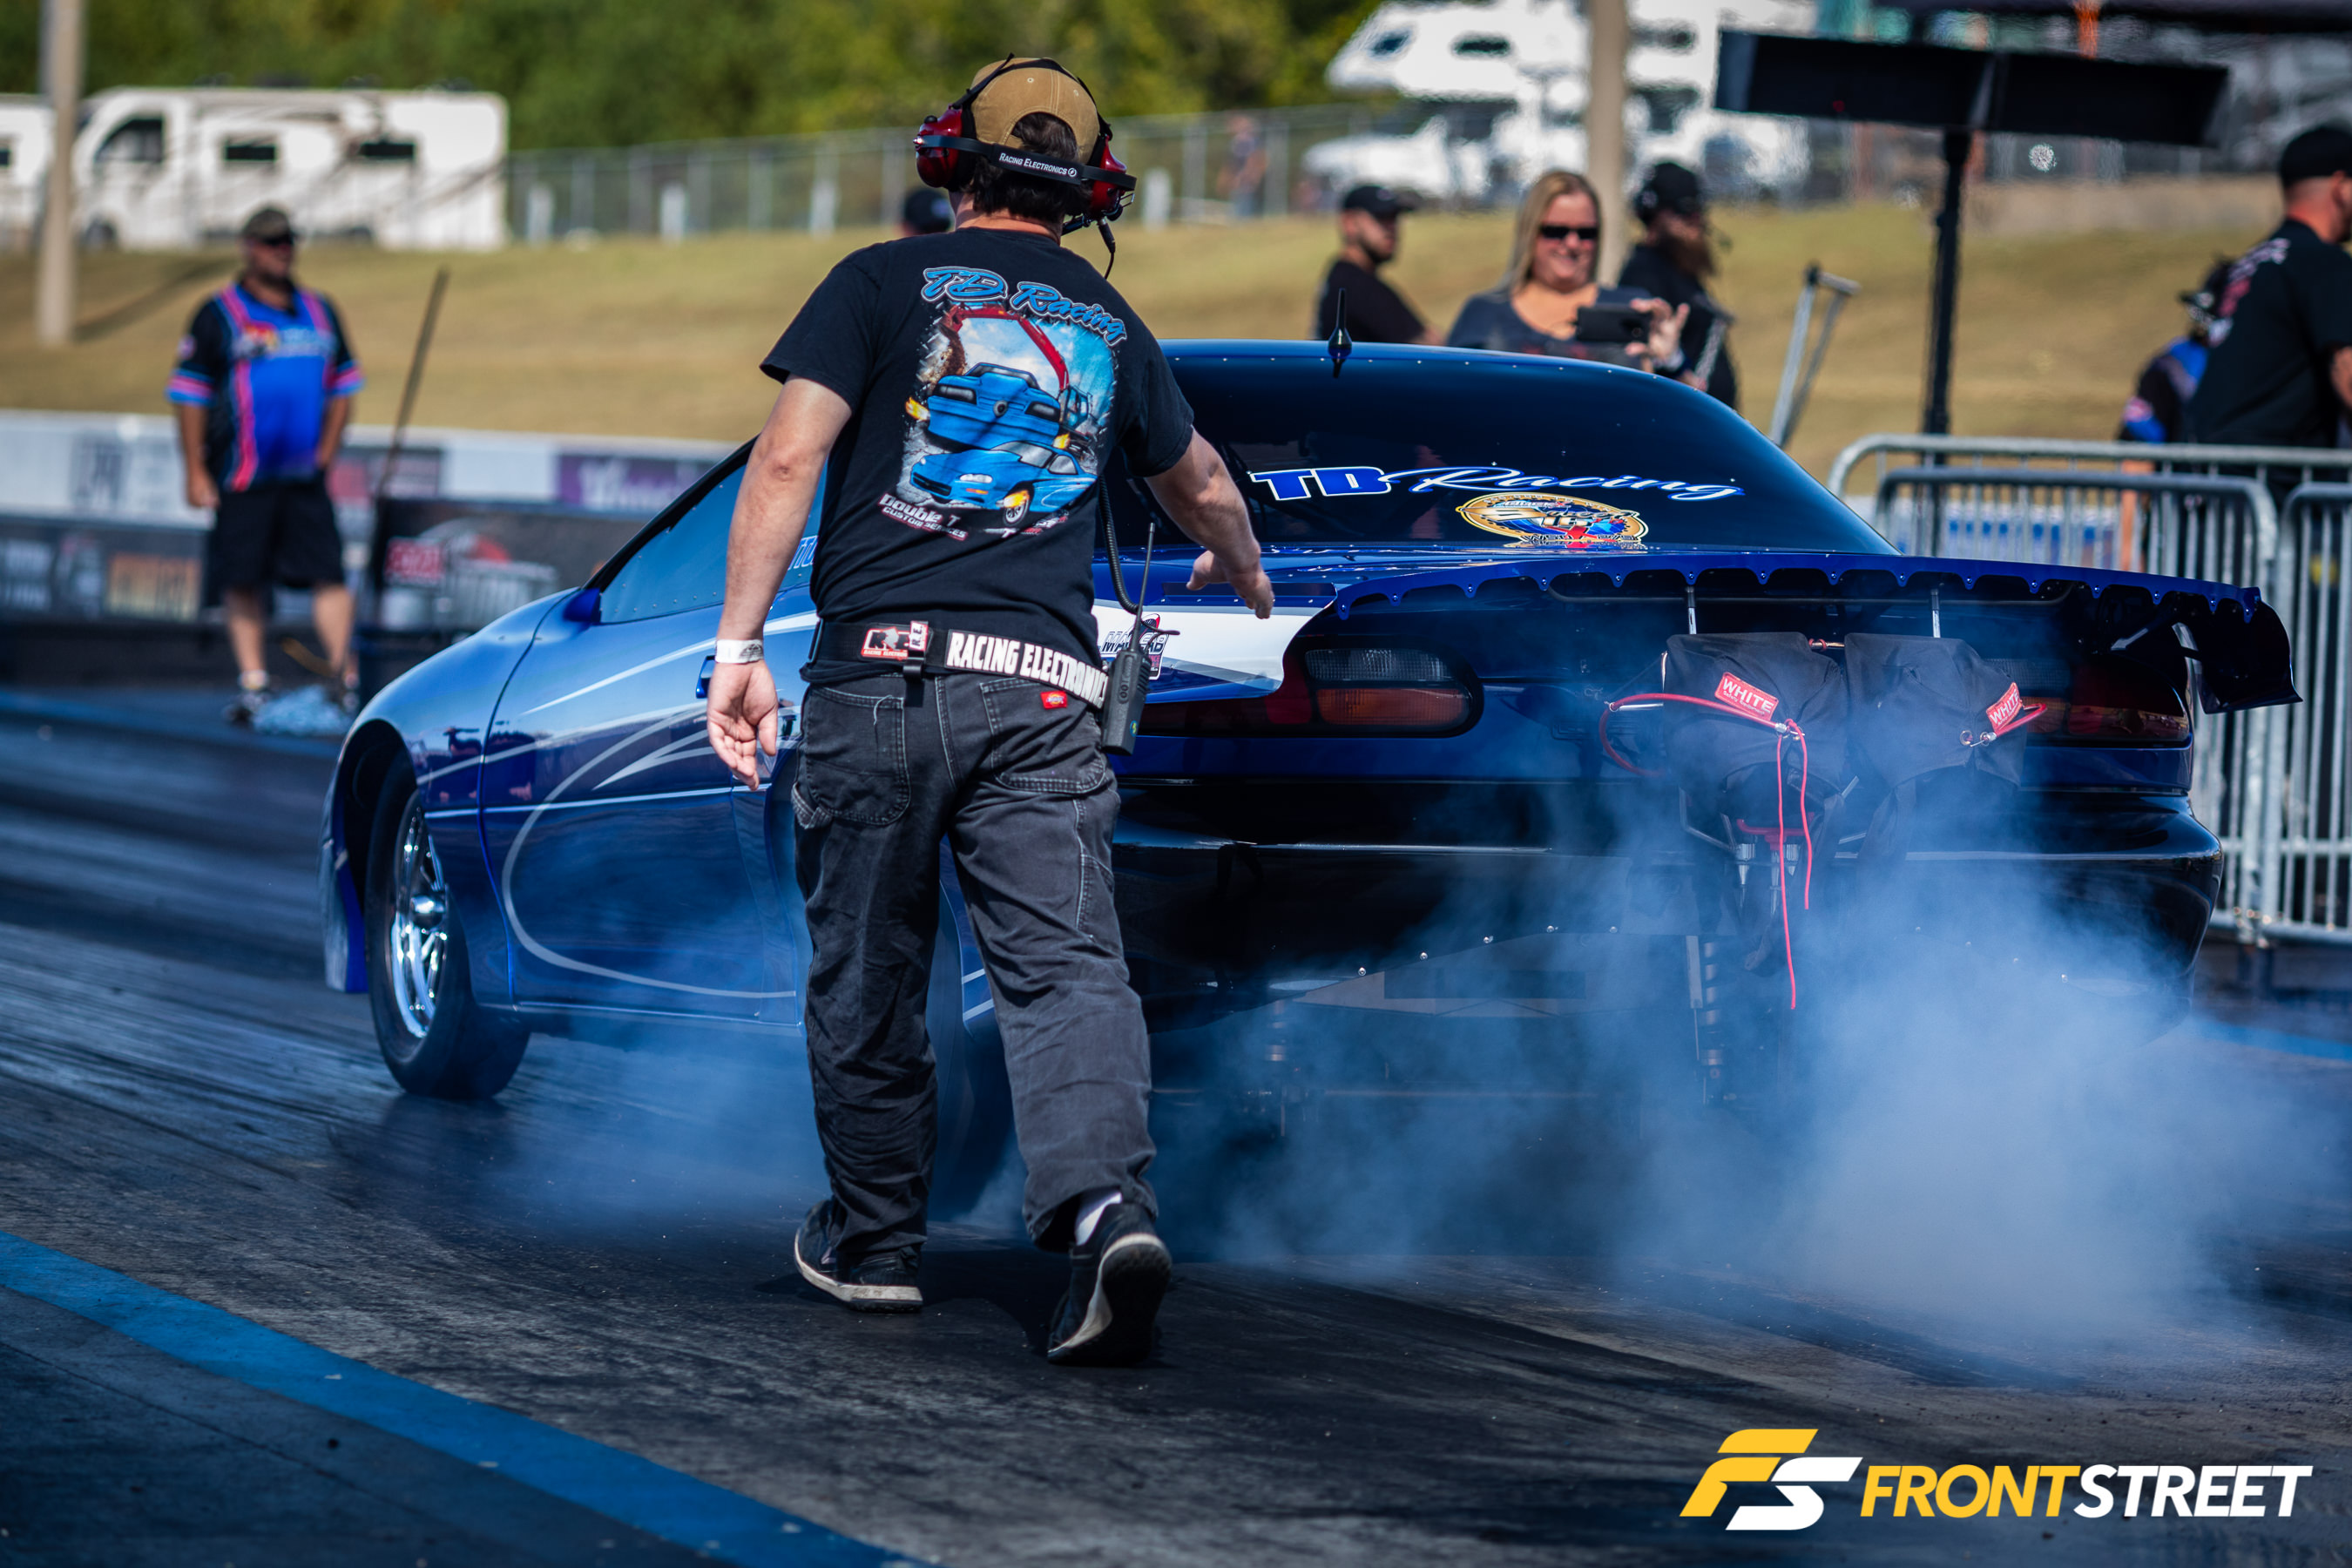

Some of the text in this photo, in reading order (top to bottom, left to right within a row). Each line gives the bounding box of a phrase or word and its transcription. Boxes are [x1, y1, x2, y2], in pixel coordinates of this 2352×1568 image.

[999, 152, 1068, 175] RACING ELECTRONICS
[921, 266, 1127, 347] TD Racing
[1249, 466, 1745, 501] TD Racing
[882, 506, 924, 528] CUSTOM
[946, 514, 961, 526] T
[946, 632, 1109, 710] RACING ELECTRONIC
[1723, 678, 1774, 713] WHITE
[1990, 688, 2018, 724] WHITE
